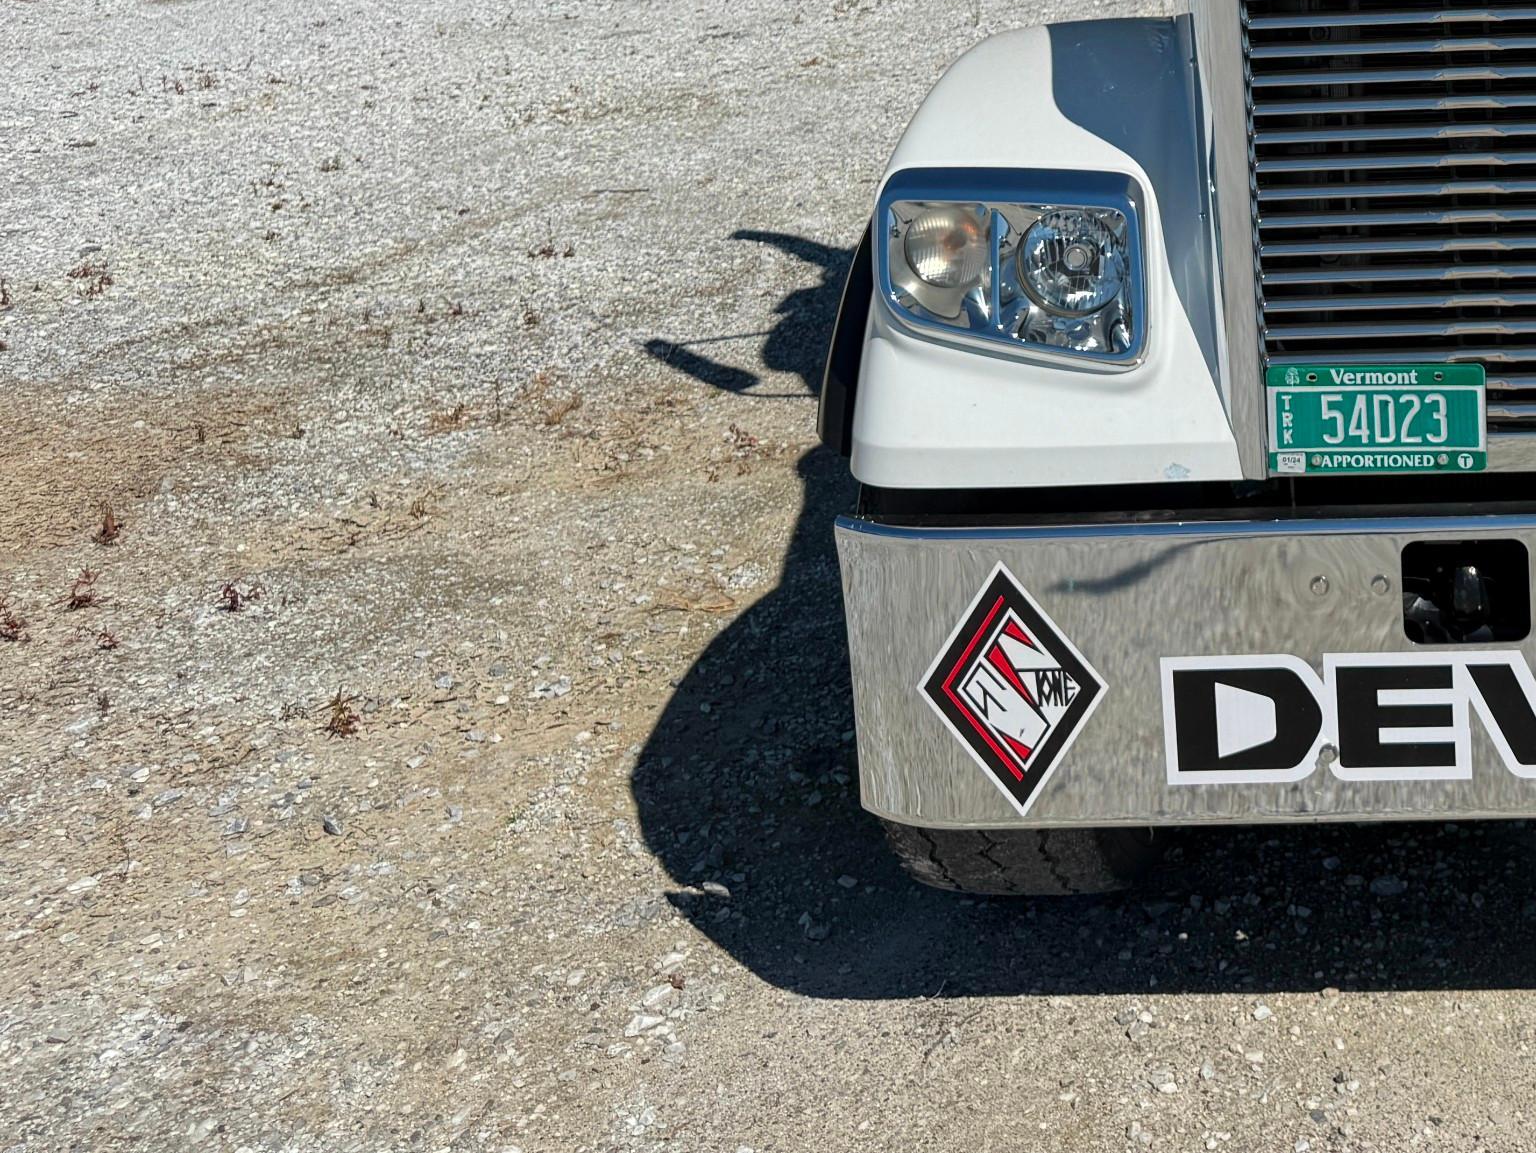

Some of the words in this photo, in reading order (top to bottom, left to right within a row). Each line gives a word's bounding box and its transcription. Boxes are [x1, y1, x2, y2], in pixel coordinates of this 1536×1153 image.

[1329, 367, 1418, 385] Vermont
[1320, 392, 1449, 445] 54D23
[1320, 453, 1435, 468] APPORTIONED
